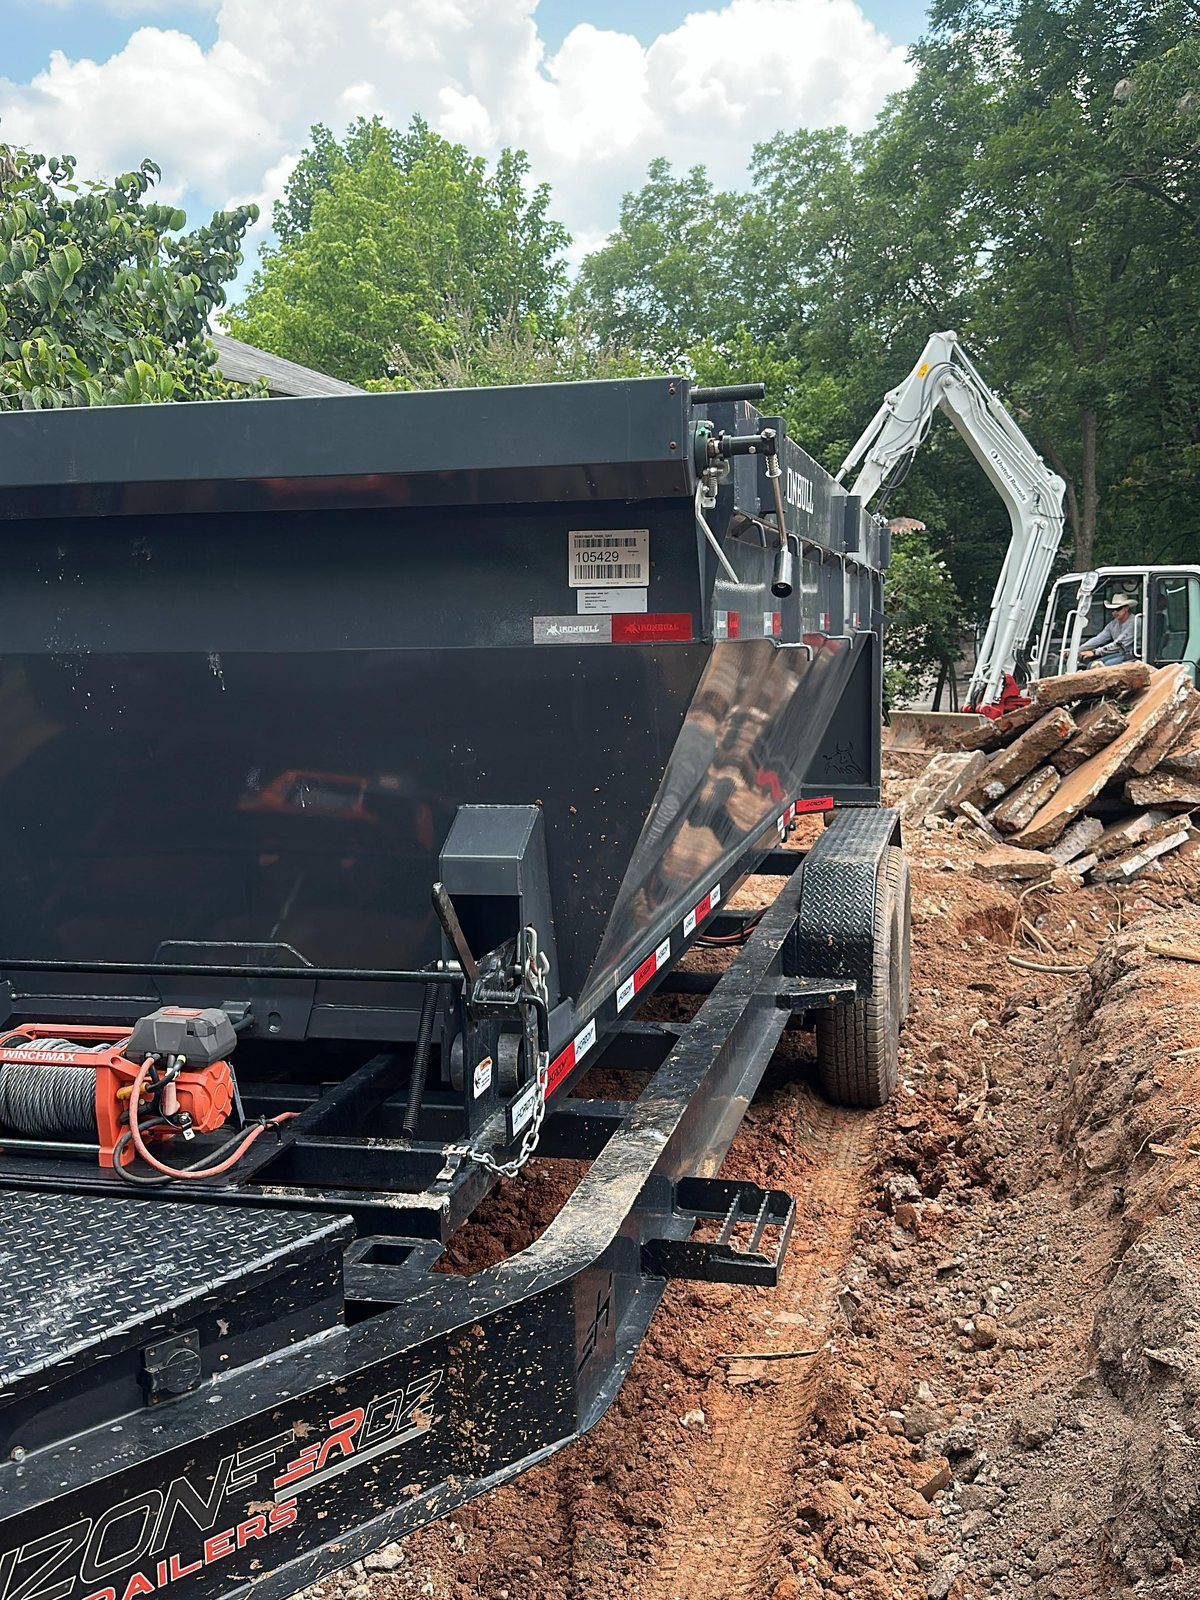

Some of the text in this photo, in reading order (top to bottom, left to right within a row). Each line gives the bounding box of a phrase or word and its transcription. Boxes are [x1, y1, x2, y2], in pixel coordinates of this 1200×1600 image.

[996, 457, 1027, 501] United Rentals
[575, 550, 619, 563] 105429
[559, 623, 600, 634] IRONBULL
[639, 623, 680, 633] IRONBULL
[2, 1049, 76, 1062] WINCHMAX
